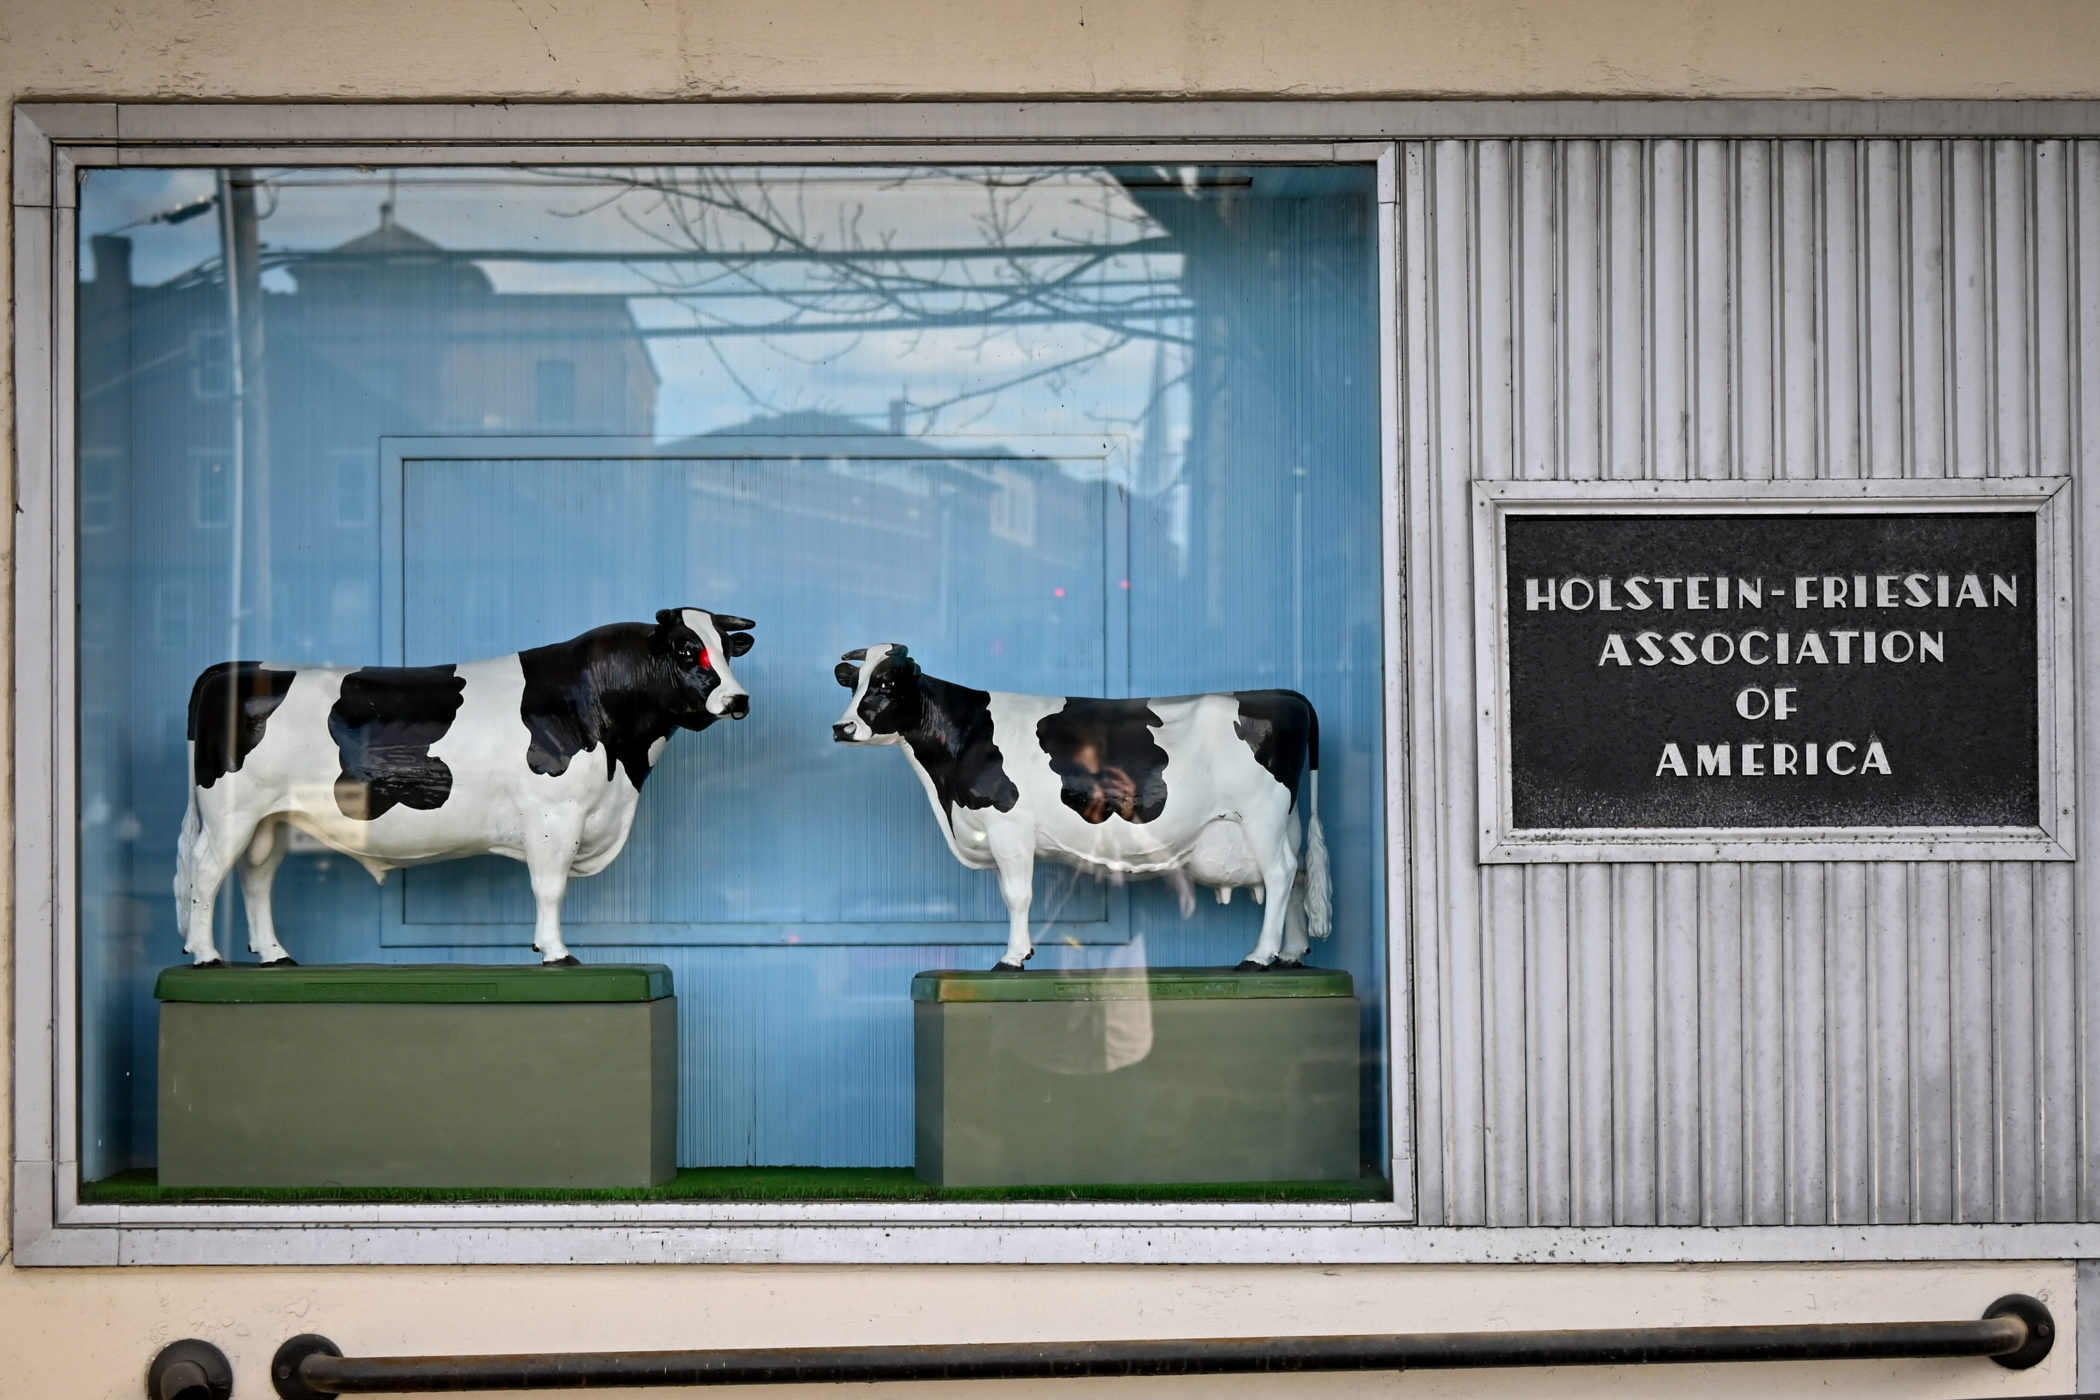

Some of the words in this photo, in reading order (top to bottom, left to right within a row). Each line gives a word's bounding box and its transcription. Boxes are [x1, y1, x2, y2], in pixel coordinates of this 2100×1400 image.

[1525, 573, 2018, 611] HOLSTEIN-FRIESIAN
[1598, 630, 1945, 667] ASSOCIATION
[1735, 686, 1798, 721] OF
[1655, 740, 1893, 777] AMERICA
